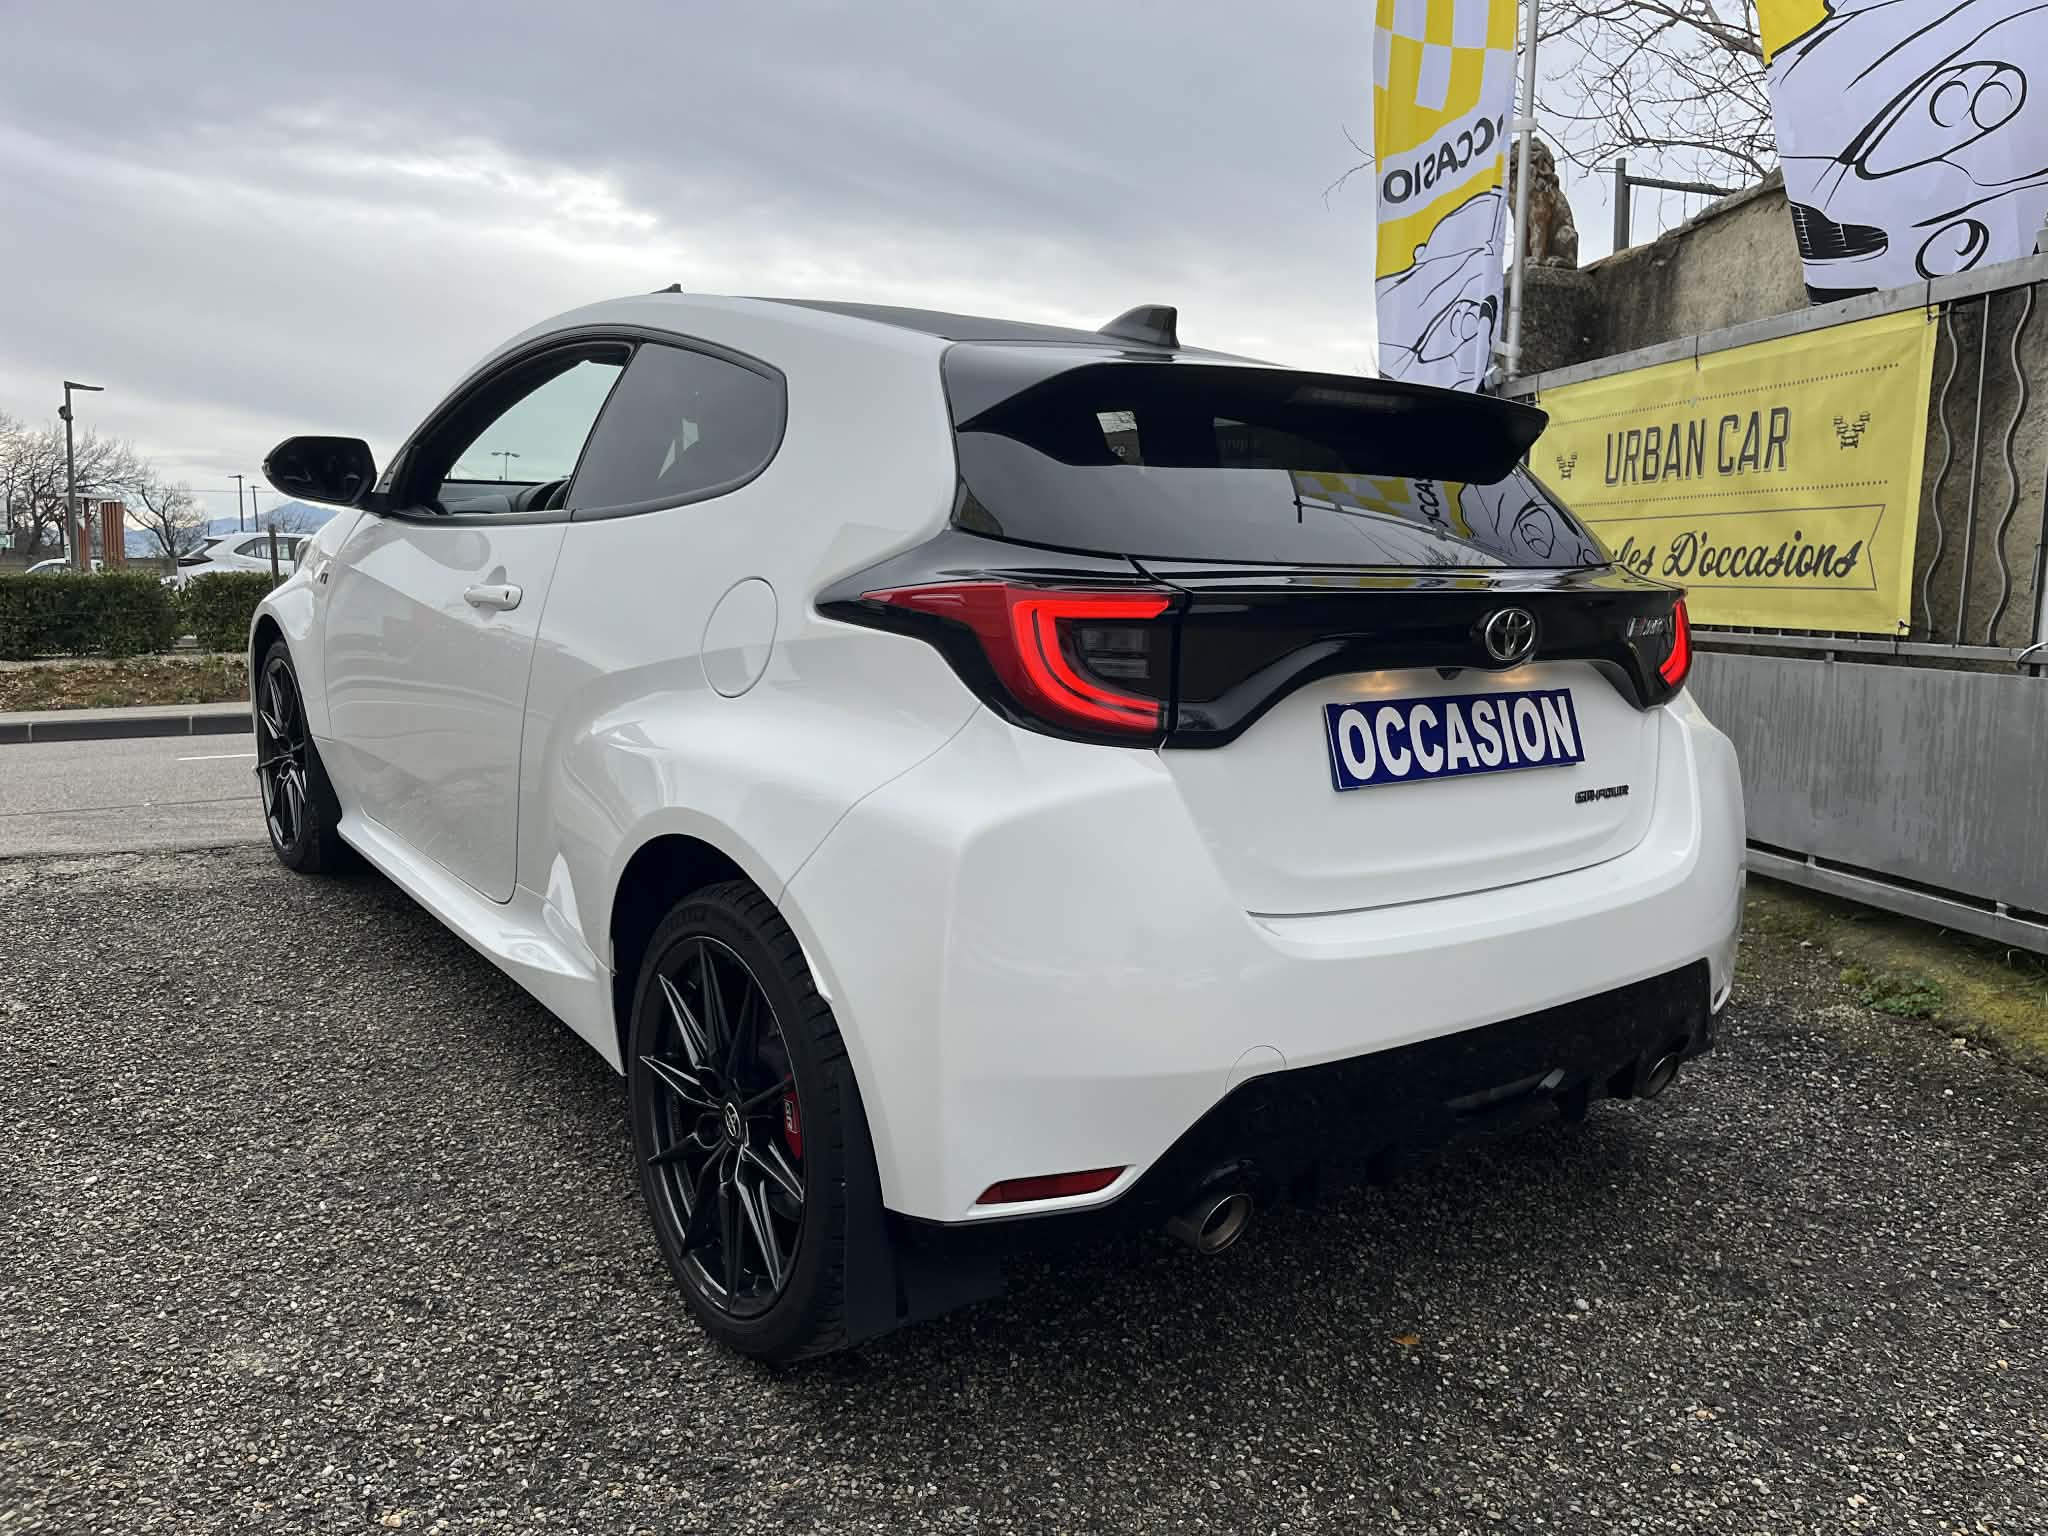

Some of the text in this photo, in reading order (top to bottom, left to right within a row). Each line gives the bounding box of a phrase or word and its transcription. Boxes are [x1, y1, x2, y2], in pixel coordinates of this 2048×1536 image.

[1605, 406, 1791, 487] URBAN CAR
[1613, 530, 1863, 578] les D'occasions
[1338, 696, 1577, 780] OCCASION
